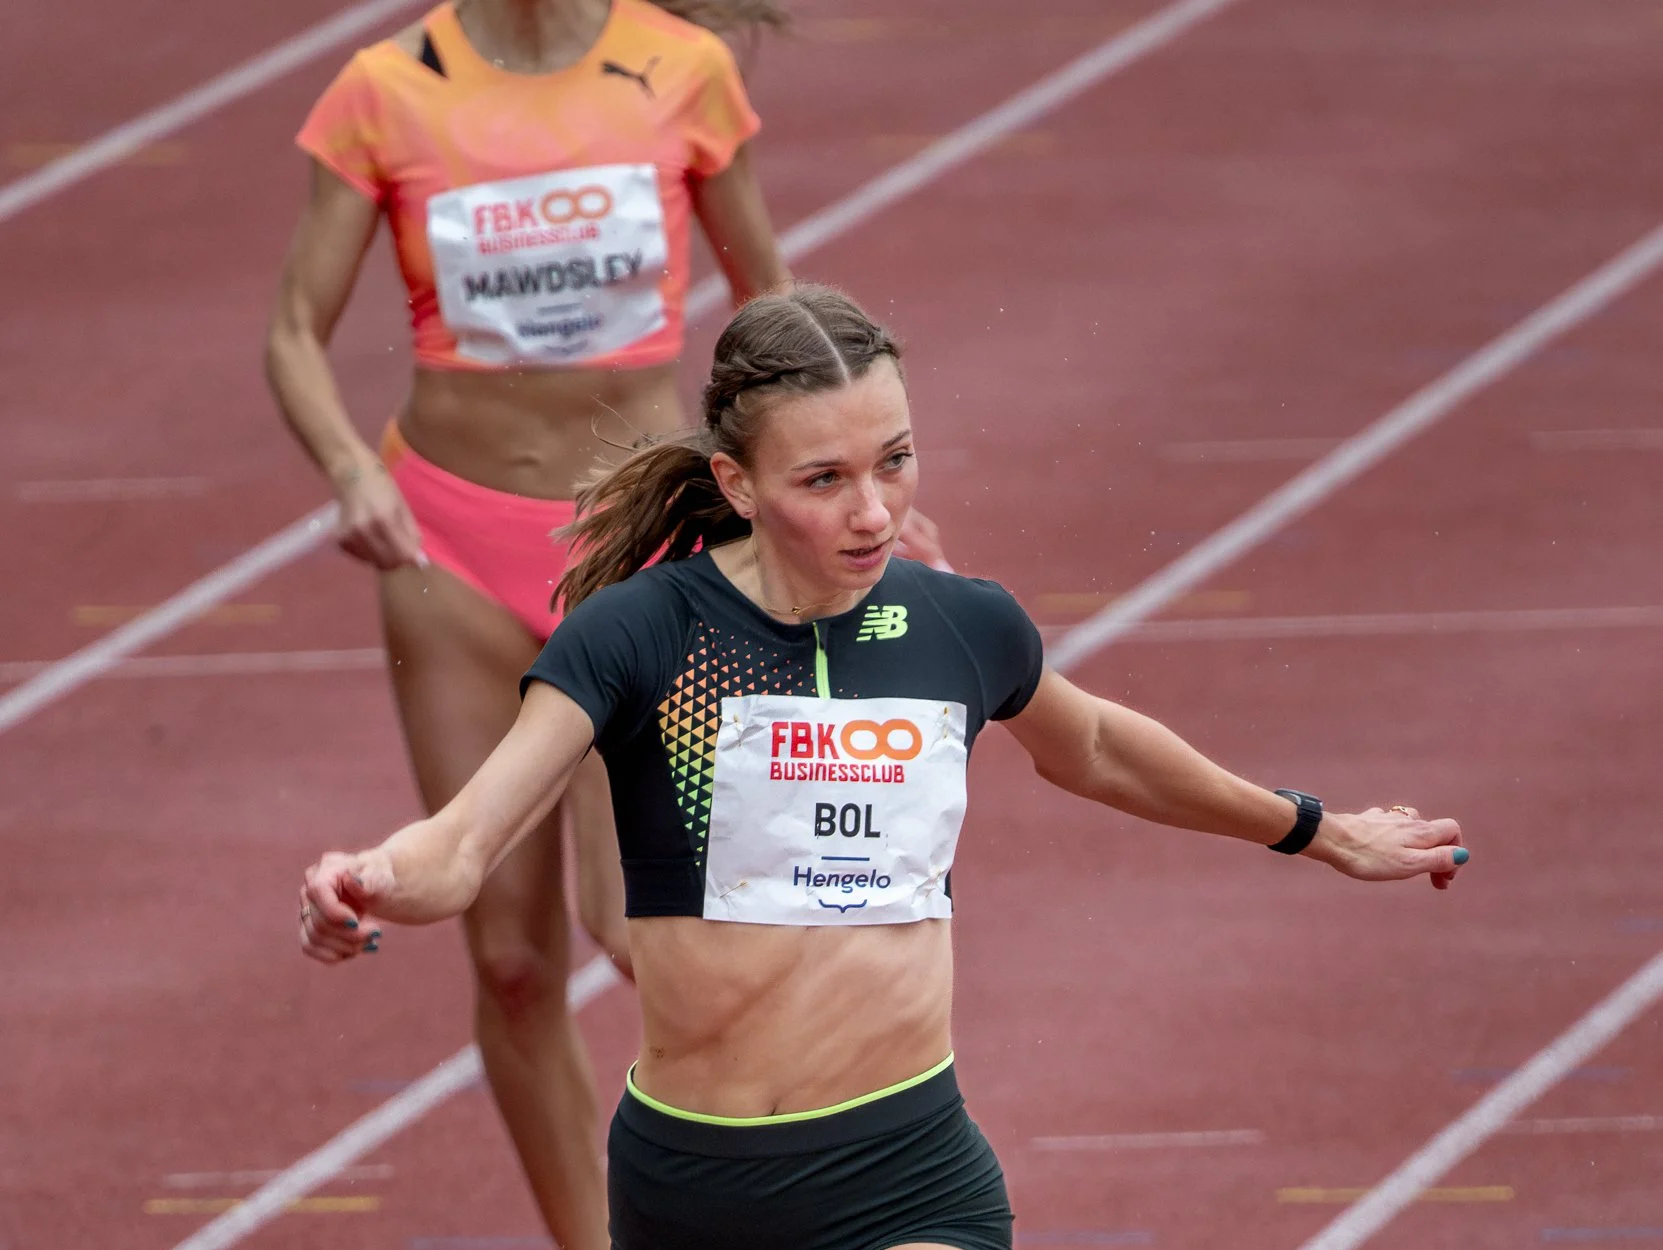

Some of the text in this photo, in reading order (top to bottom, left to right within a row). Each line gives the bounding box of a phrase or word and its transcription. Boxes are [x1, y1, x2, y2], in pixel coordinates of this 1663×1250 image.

[473, 200, 540, 236] FBK
[463, 250, 642, 301] MAWDSLEY
[770, 721, 840, 760] FBK
[769, 762, 905, 784] BUSINESSCLUB
[814, 802, 881, 838] BOL
[792, 865, 892, 894] Hengelo
